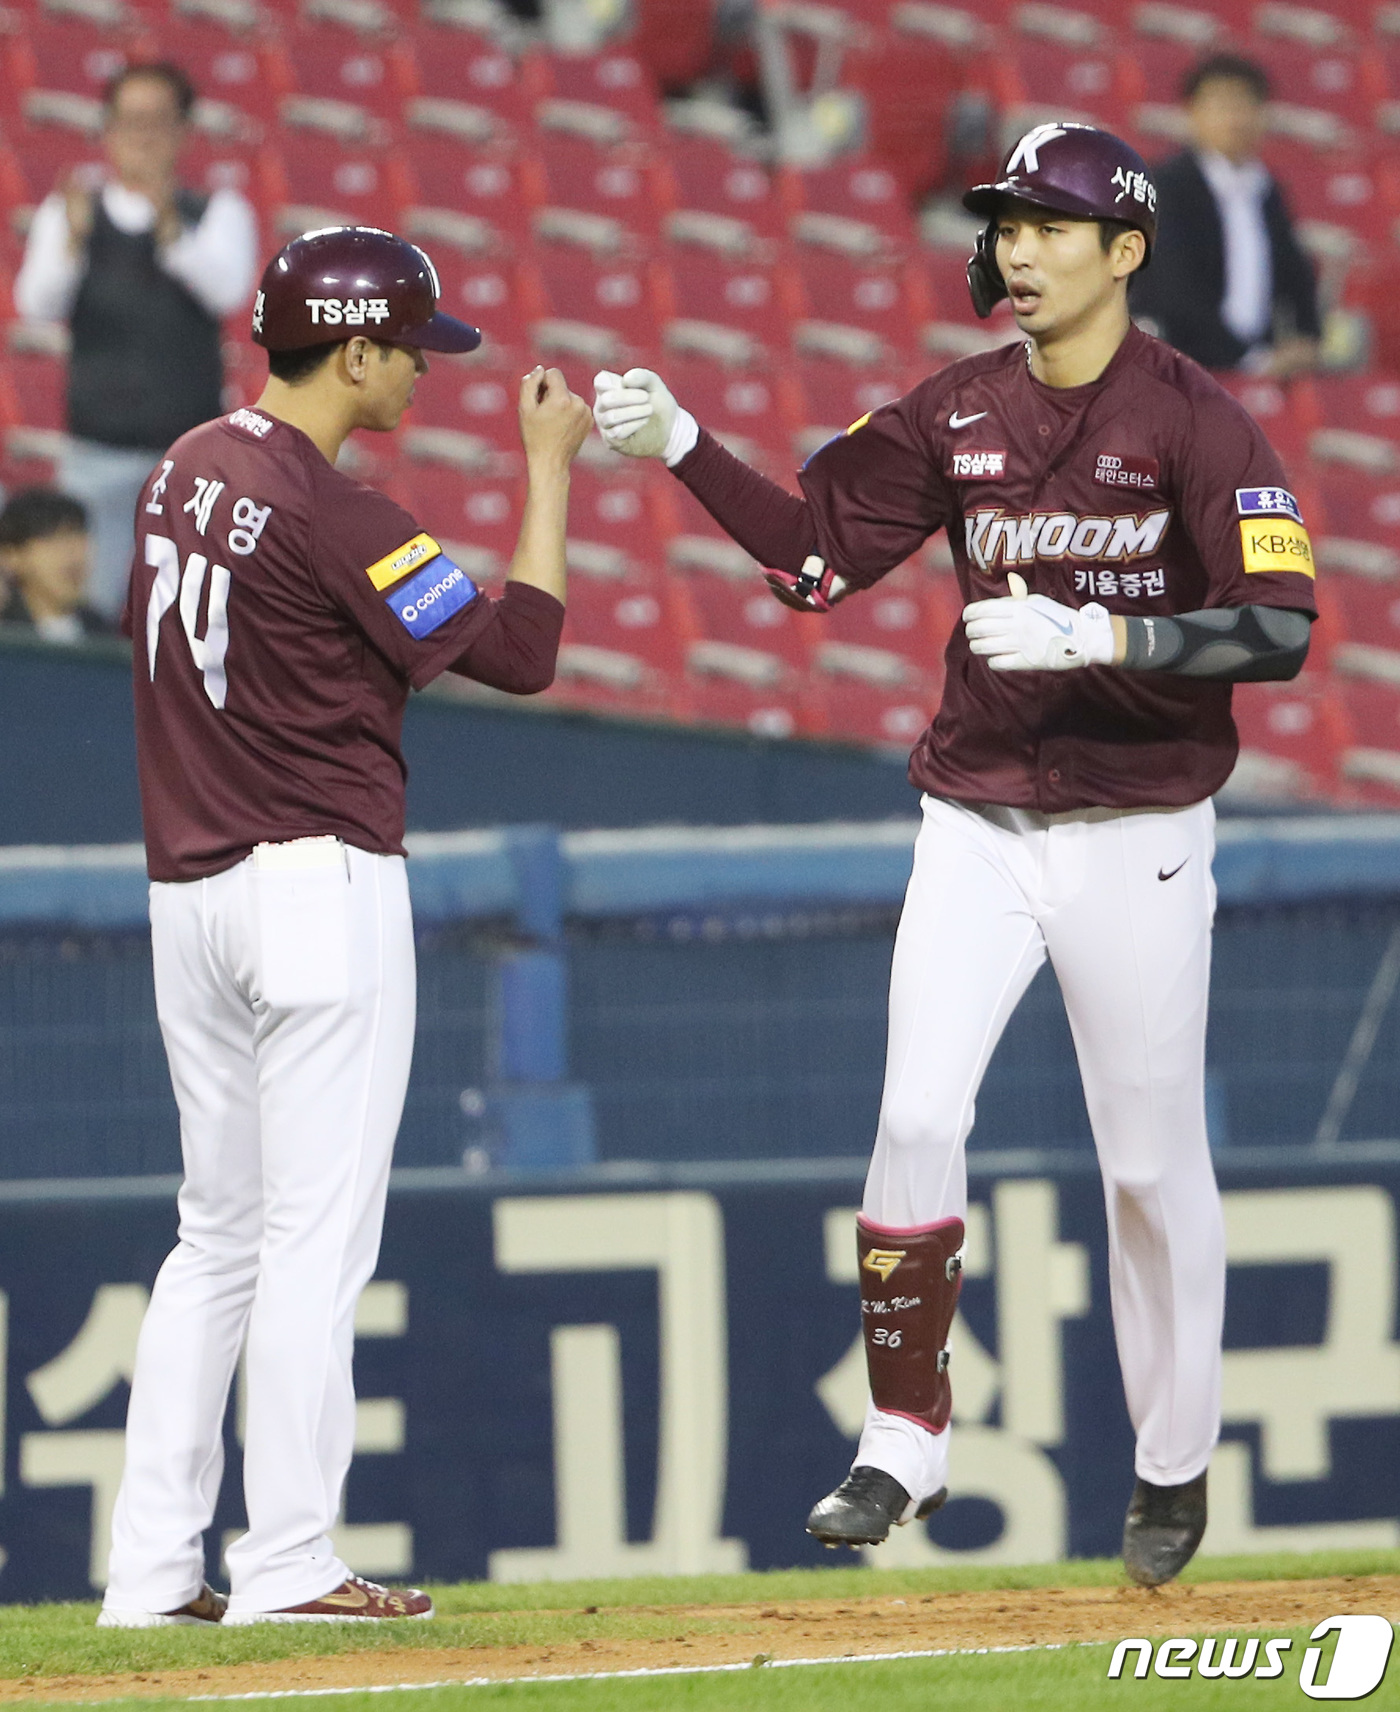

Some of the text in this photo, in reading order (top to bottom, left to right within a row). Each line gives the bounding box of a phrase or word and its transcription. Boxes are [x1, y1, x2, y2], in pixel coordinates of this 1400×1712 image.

[305, 298, 390, 325] TS샴푸
[1094, 467, 1155, 488] 태안모터스
[145, 460, 272, 556] 조재영
[965, 508, 1170, 573] KIWOOM
[1074, 568, 1166, 598] 키움증권
[144, 533, 231, 710] 74
[872, 1328, 902, 1348] 36
